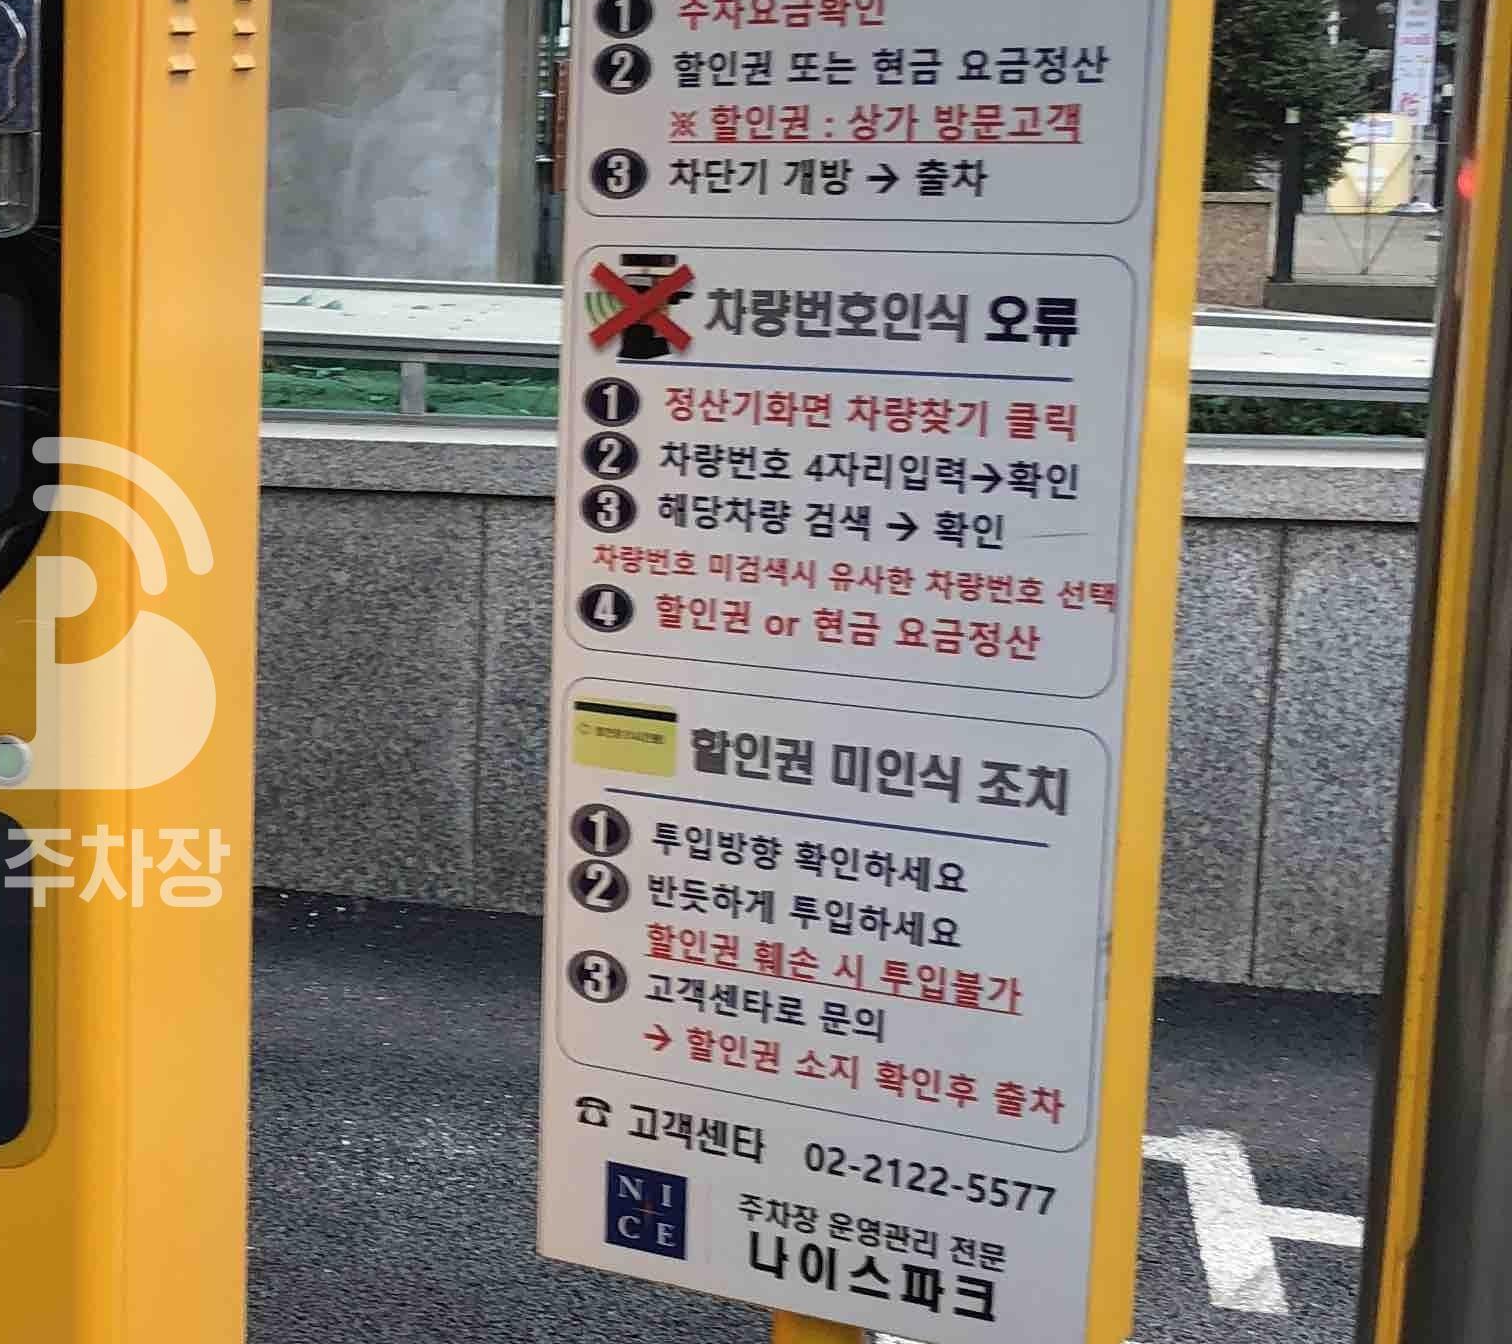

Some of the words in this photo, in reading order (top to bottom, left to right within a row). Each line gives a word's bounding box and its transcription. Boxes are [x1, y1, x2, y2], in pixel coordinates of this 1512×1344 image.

[673, 50, 773, 88] 할인권
[788, 51, 857, 86] 또는
[872, 47, 942, 86] 현금
[958, 46, 1109, 86] 요금정산
[711, 105, 810, 142] 할인권
[847, 105, 918, 142] 상가
[933, 103, 1082, 143] 방문고객
[669, 159, 768, 195] 차단기
[783, 160, 853, 196] 개방
[916, 159, 988, 198] 출차
[704, 287, 968, 343] 차량번호인식
[986, 296, 1079, 347] 오류
[664, 387, 833, 429] 정산기화면
[846, 394, 988, 436] 차량찾기
[1005, 402, 1077, 442] 클릭
[659, 441, 792, 480] 차량번호
[657, 492, 791, 535] 해당차량
[804, 503, 871, 542] 검색
[934, 511, 1005, 550] 확인
[593, 543, 697, 578] 차량번호
[708, 552, 817, 589] 미검색시
[828, 562, 914, 597] 유사한
[926, 568, 1044, 607] 차량번호
[1057, 577, 1118, 613] 선택
[656, 593, 750, 635] 할인권
[765, 612, 799, 637] or
[813, 607, 880, 647] 현금
[895, 616, 1040, 661] 요금정산
[690, 726, 815, 784] 할인권
[831, 743, 961, 803] 미인식
[978, 759, 1071, 816] 조치
[650, 821, 782, 870] 투입방향
[794, 840, 968, 895] 확인하세요
[646, 873, 775, 925] 반듯하게
[790, 895, 962, 949] 투입하세요
[645, 923, 741, 968] 할인권
[754, 938, 820, 981] 훼손
[834, 949, 864, 991] 시
[880, 958, 1023, 1012] 투입불가
[644, 972, 806, 1027] 고객센타로
[819, 1002, 886, 1043] 문의
[686, 1027, 780, 1075] 할인권
[795, 1047, 859, 1090] 소지
[875, 1060, 979, 1109] 확인후
[994, 1081, 1066, 1125] 출차
[627, 1103, 765, 1164] 고객센타
[804, 1141, 1057, 1217] 02-2122-5577
[738, 1192, 818, 1235] 주차장
[828, 1211, 939, 1259] 운영관리
[949, 1236, 1007, 1273] 전문
[748, 1230, 997, 1323] 나이스파크
